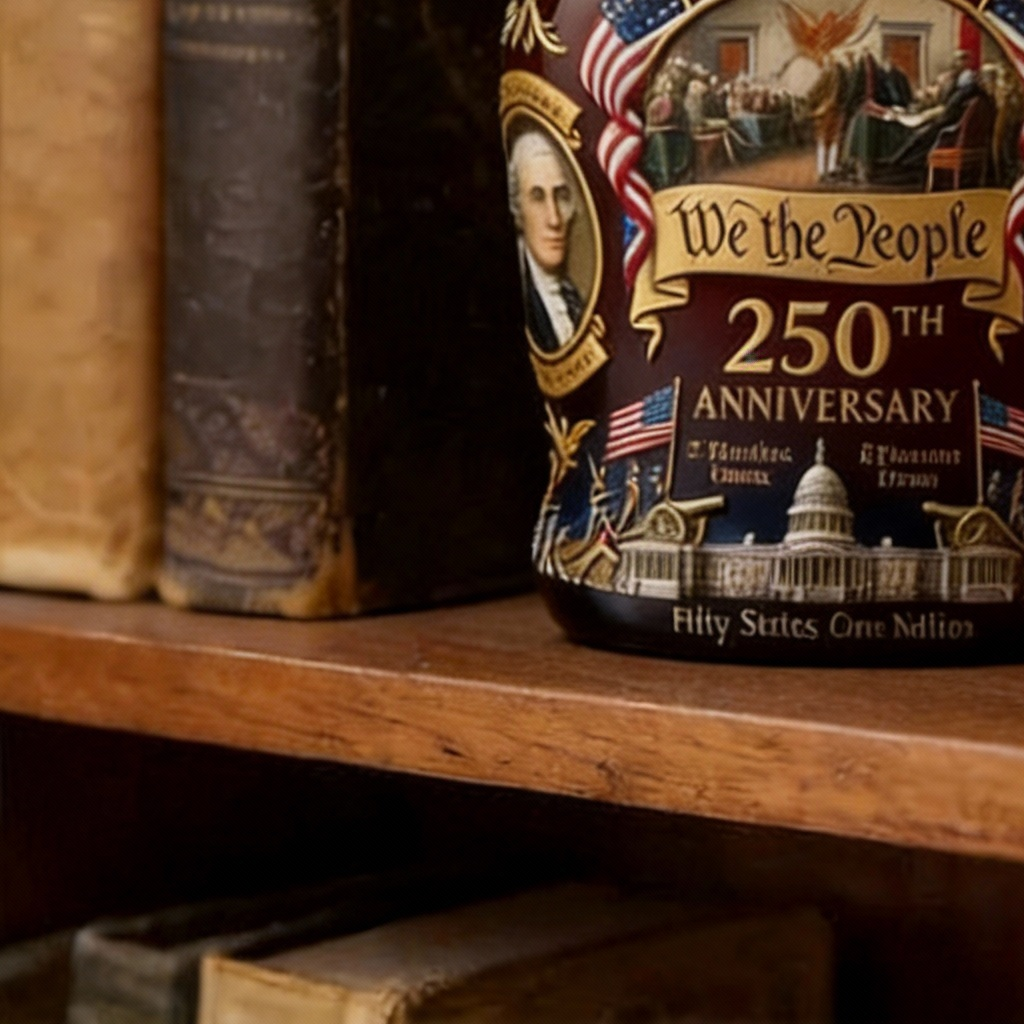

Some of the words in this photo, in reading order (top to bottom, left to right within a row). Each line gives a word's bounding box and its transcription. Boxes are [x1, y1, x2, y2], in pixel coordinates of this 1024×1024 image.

[668, 196, 764, 259] We
[761, 198, 828, 267] the
[826, 200, 989, 280] People
[692, 384, 960, 424] ANNIVERSARY
